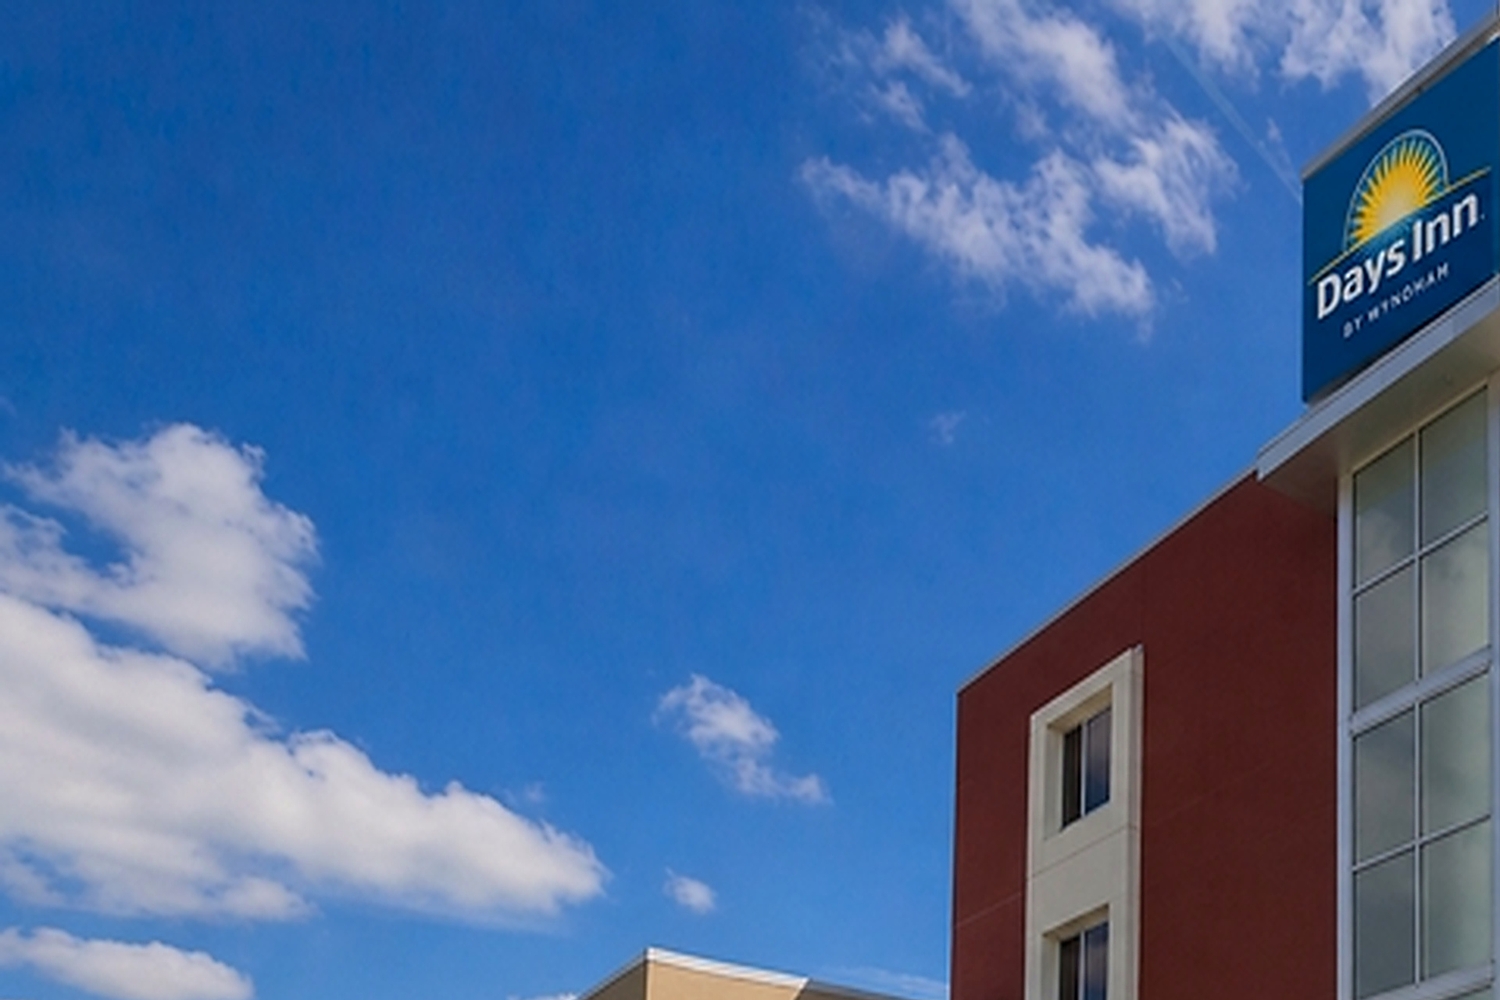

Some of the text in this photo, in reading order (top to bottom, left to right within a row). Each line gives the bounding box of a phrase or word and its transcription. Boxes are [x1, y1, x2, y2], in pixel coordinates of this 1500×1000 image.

[1317, 193, 1478, 320] Days Inn
[1343, 262, 1449, 338] BY WYNDHAM
